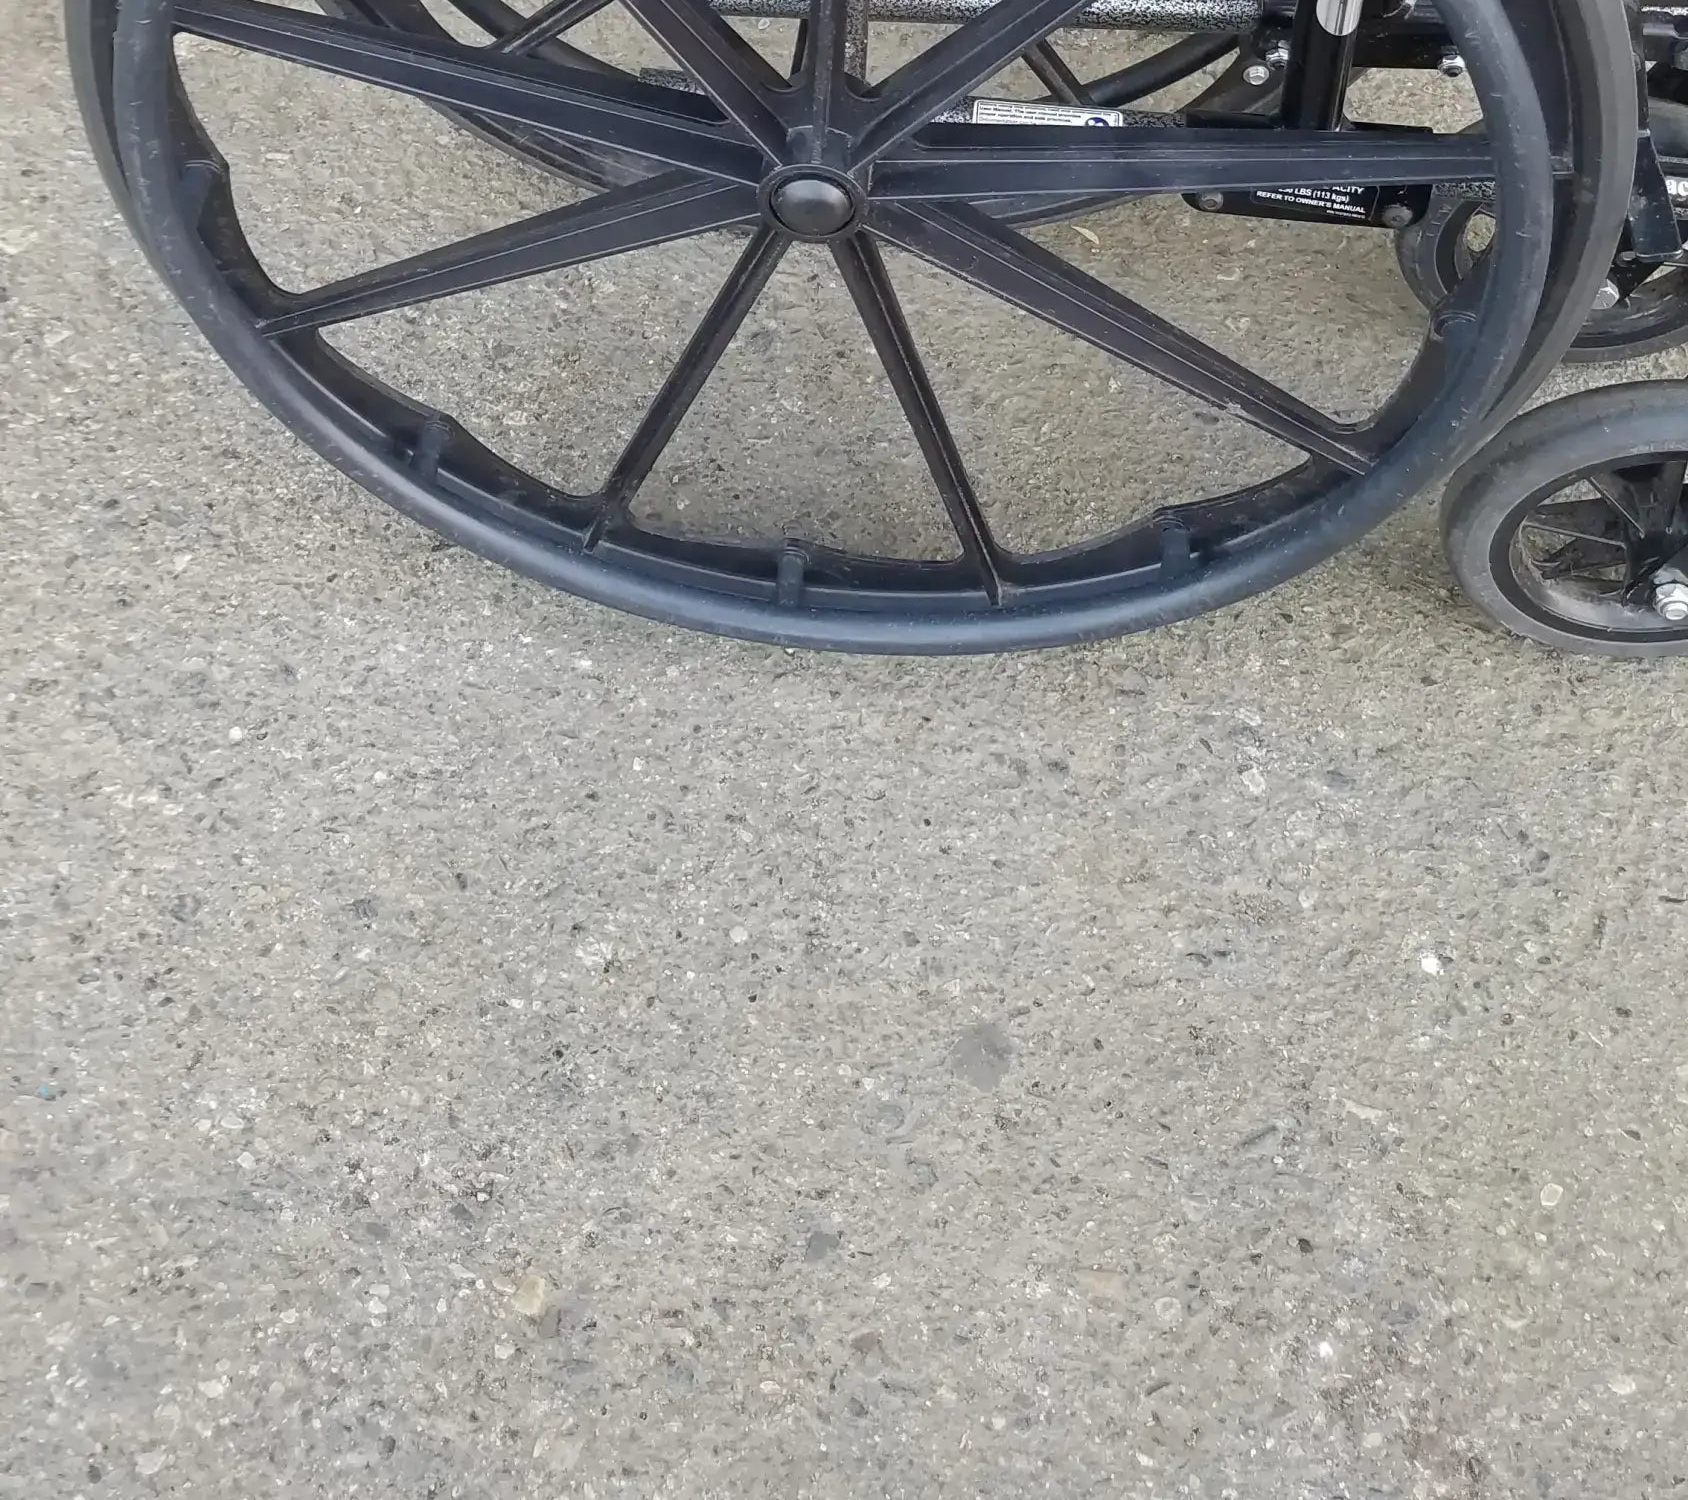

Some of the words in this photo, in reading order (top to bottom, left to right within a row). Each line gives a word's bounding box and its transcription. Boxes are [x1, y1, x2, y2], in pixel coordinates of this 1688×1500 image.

[1257, 191, 1283, 200] REFER
[1296, 197, 1332, 207] OWNER'S
[1333, 203, 1366, 213] MANUAL
[1294, 187, 1312, 197] LBS
[1313, 189, 1331, 199] (113
[1331, 192, 1350, 203] kgs)
